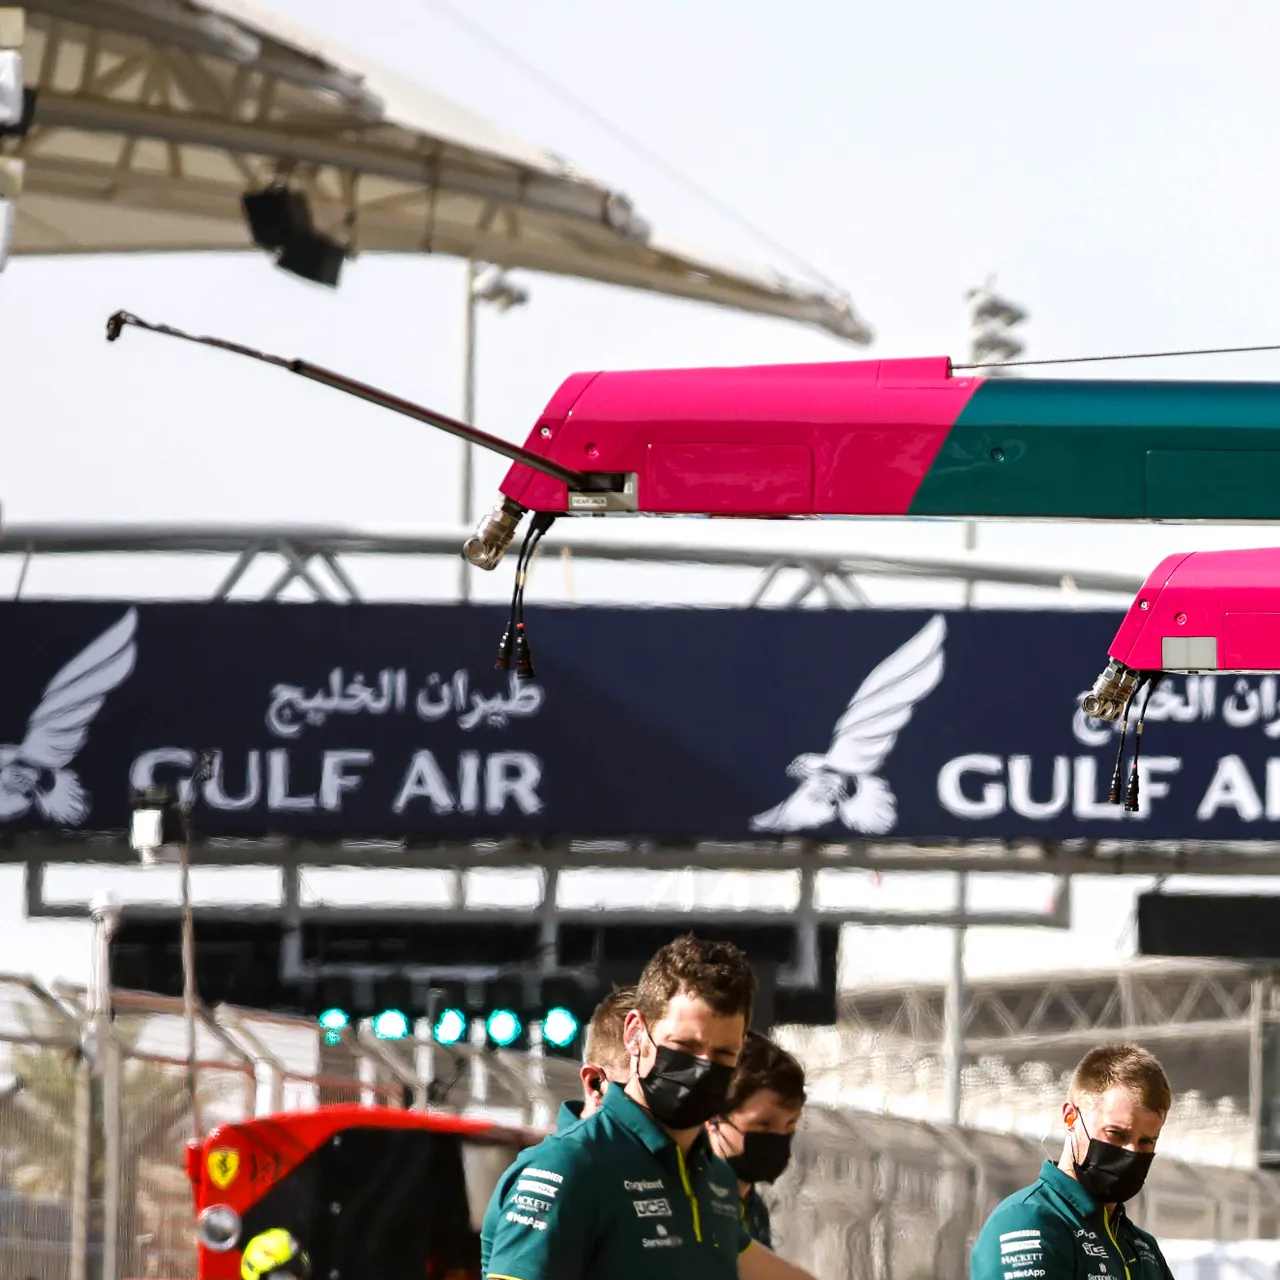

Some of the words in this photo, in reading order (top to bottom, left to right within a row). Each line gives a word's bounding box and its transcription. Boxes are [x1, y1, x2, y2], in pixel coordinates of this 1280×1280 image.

[266, 665, 407, 737] الخليج
[416, 667, 545, 731] طيران
[130, 748, 374, 812] GULF
[393, 749, 544, 815] AIR
[937, 754, 1182, 820] GULF
[635, 1199, 671, 1216] JCB
[1001, 1253, 1043, 1264] HACKETT
[1012, 1269, 1046, 1278] NetApp
